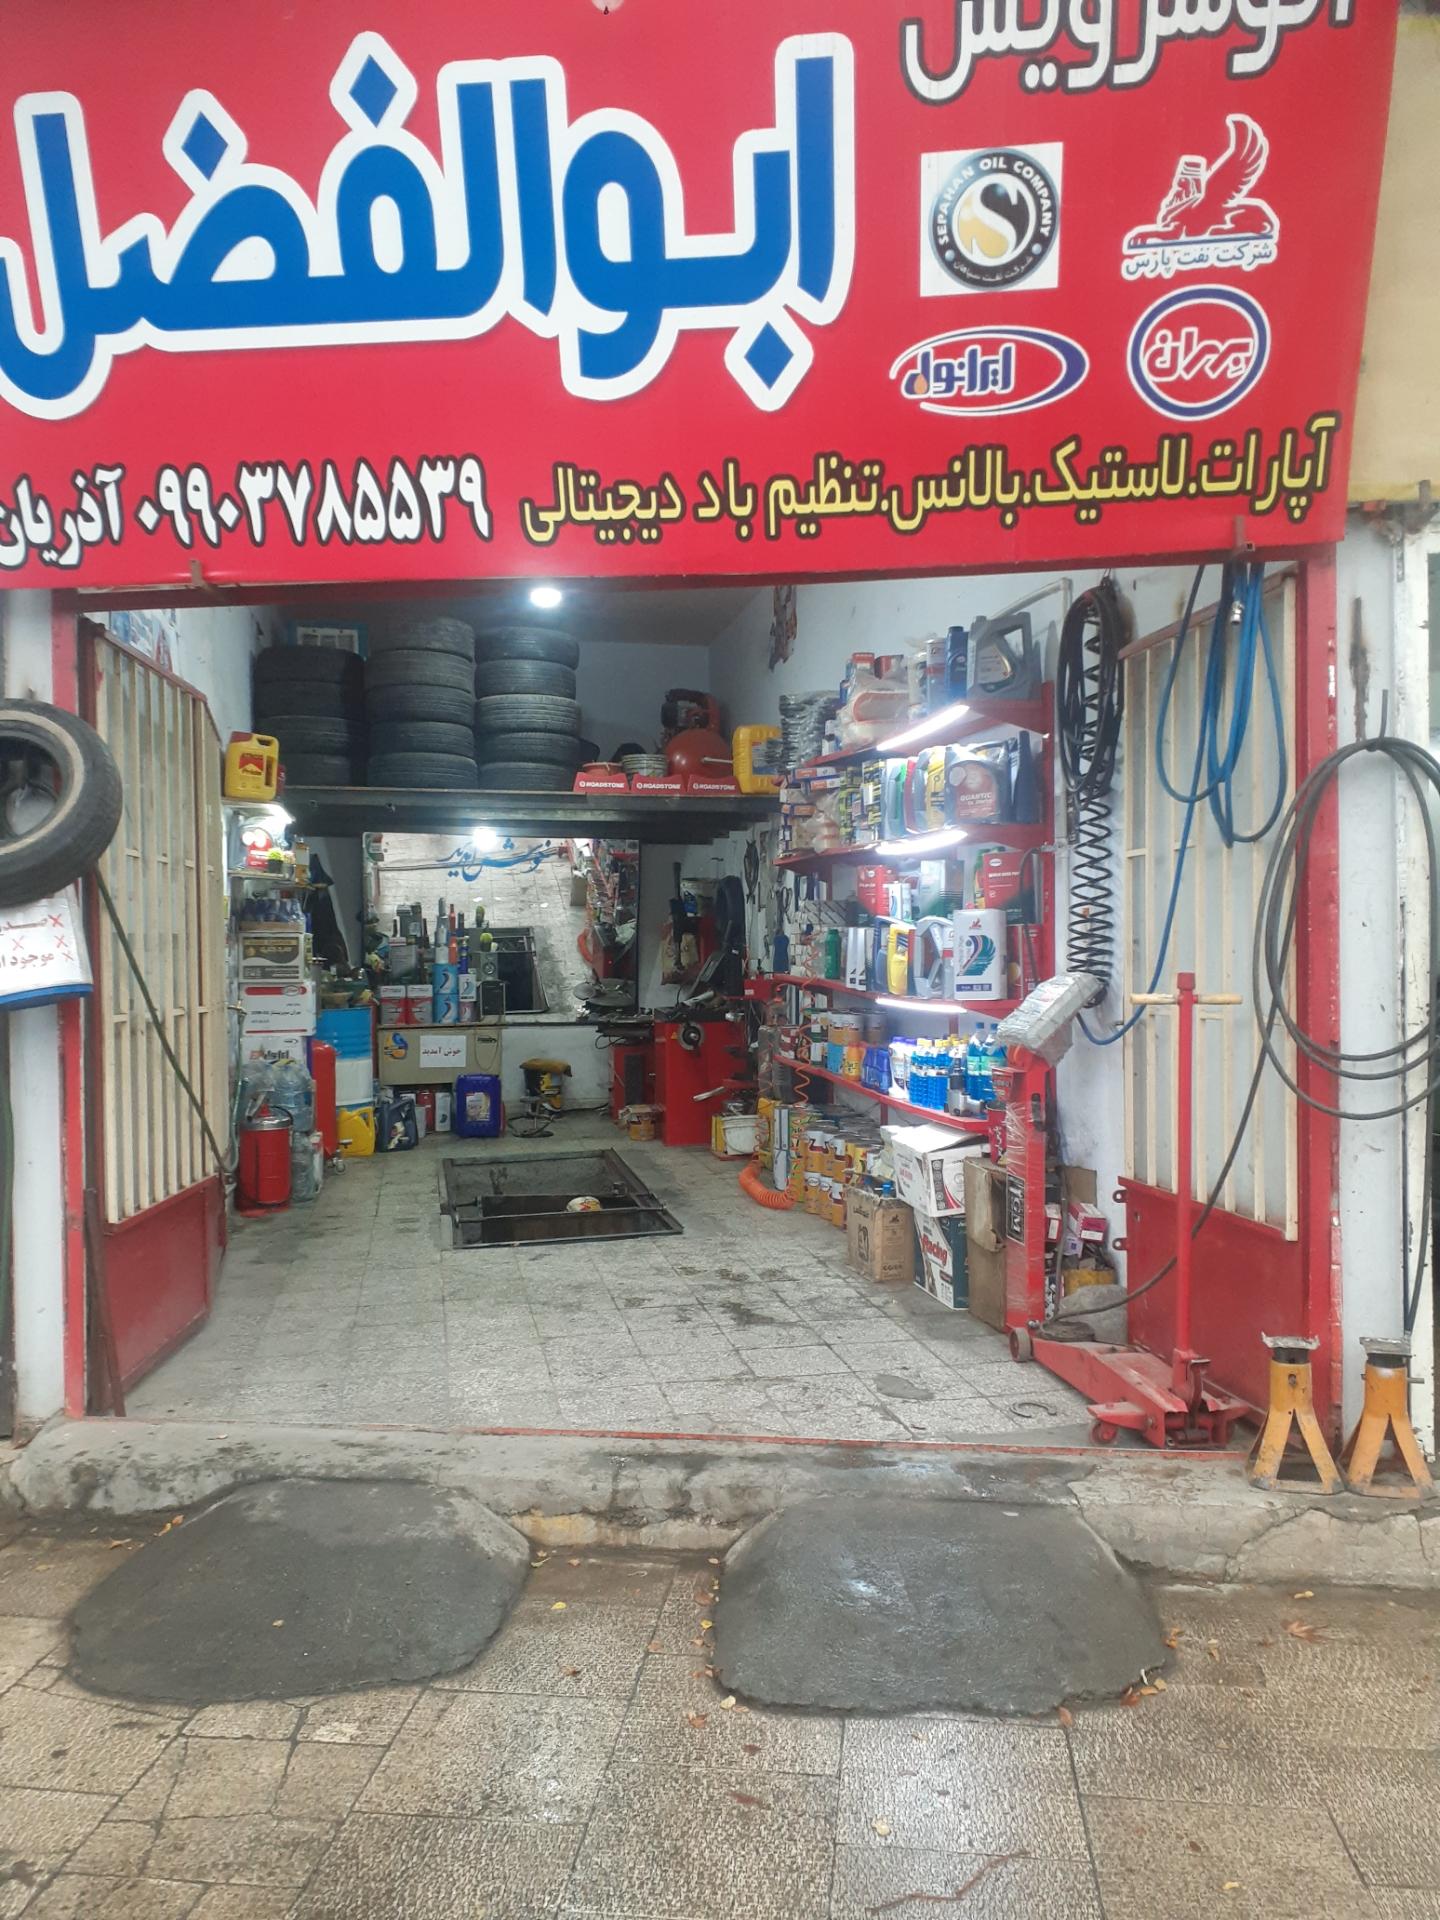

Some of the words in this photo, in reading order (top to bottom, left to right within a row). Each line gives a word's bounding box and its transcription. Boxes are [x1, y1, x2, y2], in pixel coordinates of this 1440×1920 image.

[936, 166, 975, 246] SEPAHAN
[979, 156, 1007, 171] OIL
[1013, 160, 1052, 238] COMPANY
[0, 36, 848, 416] ابوالفضل
[1125, 249, 1171, 277] پارس
[1176, 247, 1209, 267] نفت
[1214, 242, 1273, 267] شرکت
[902, 343, 1015, 398] ایرانول
[522, 466, 683, 542] دیجیتالی
[697, 461, 754, 537] باد
[585, 781, 625, 789] ROADSTONE
[642, 782, 681, 791] ROADSTONE
